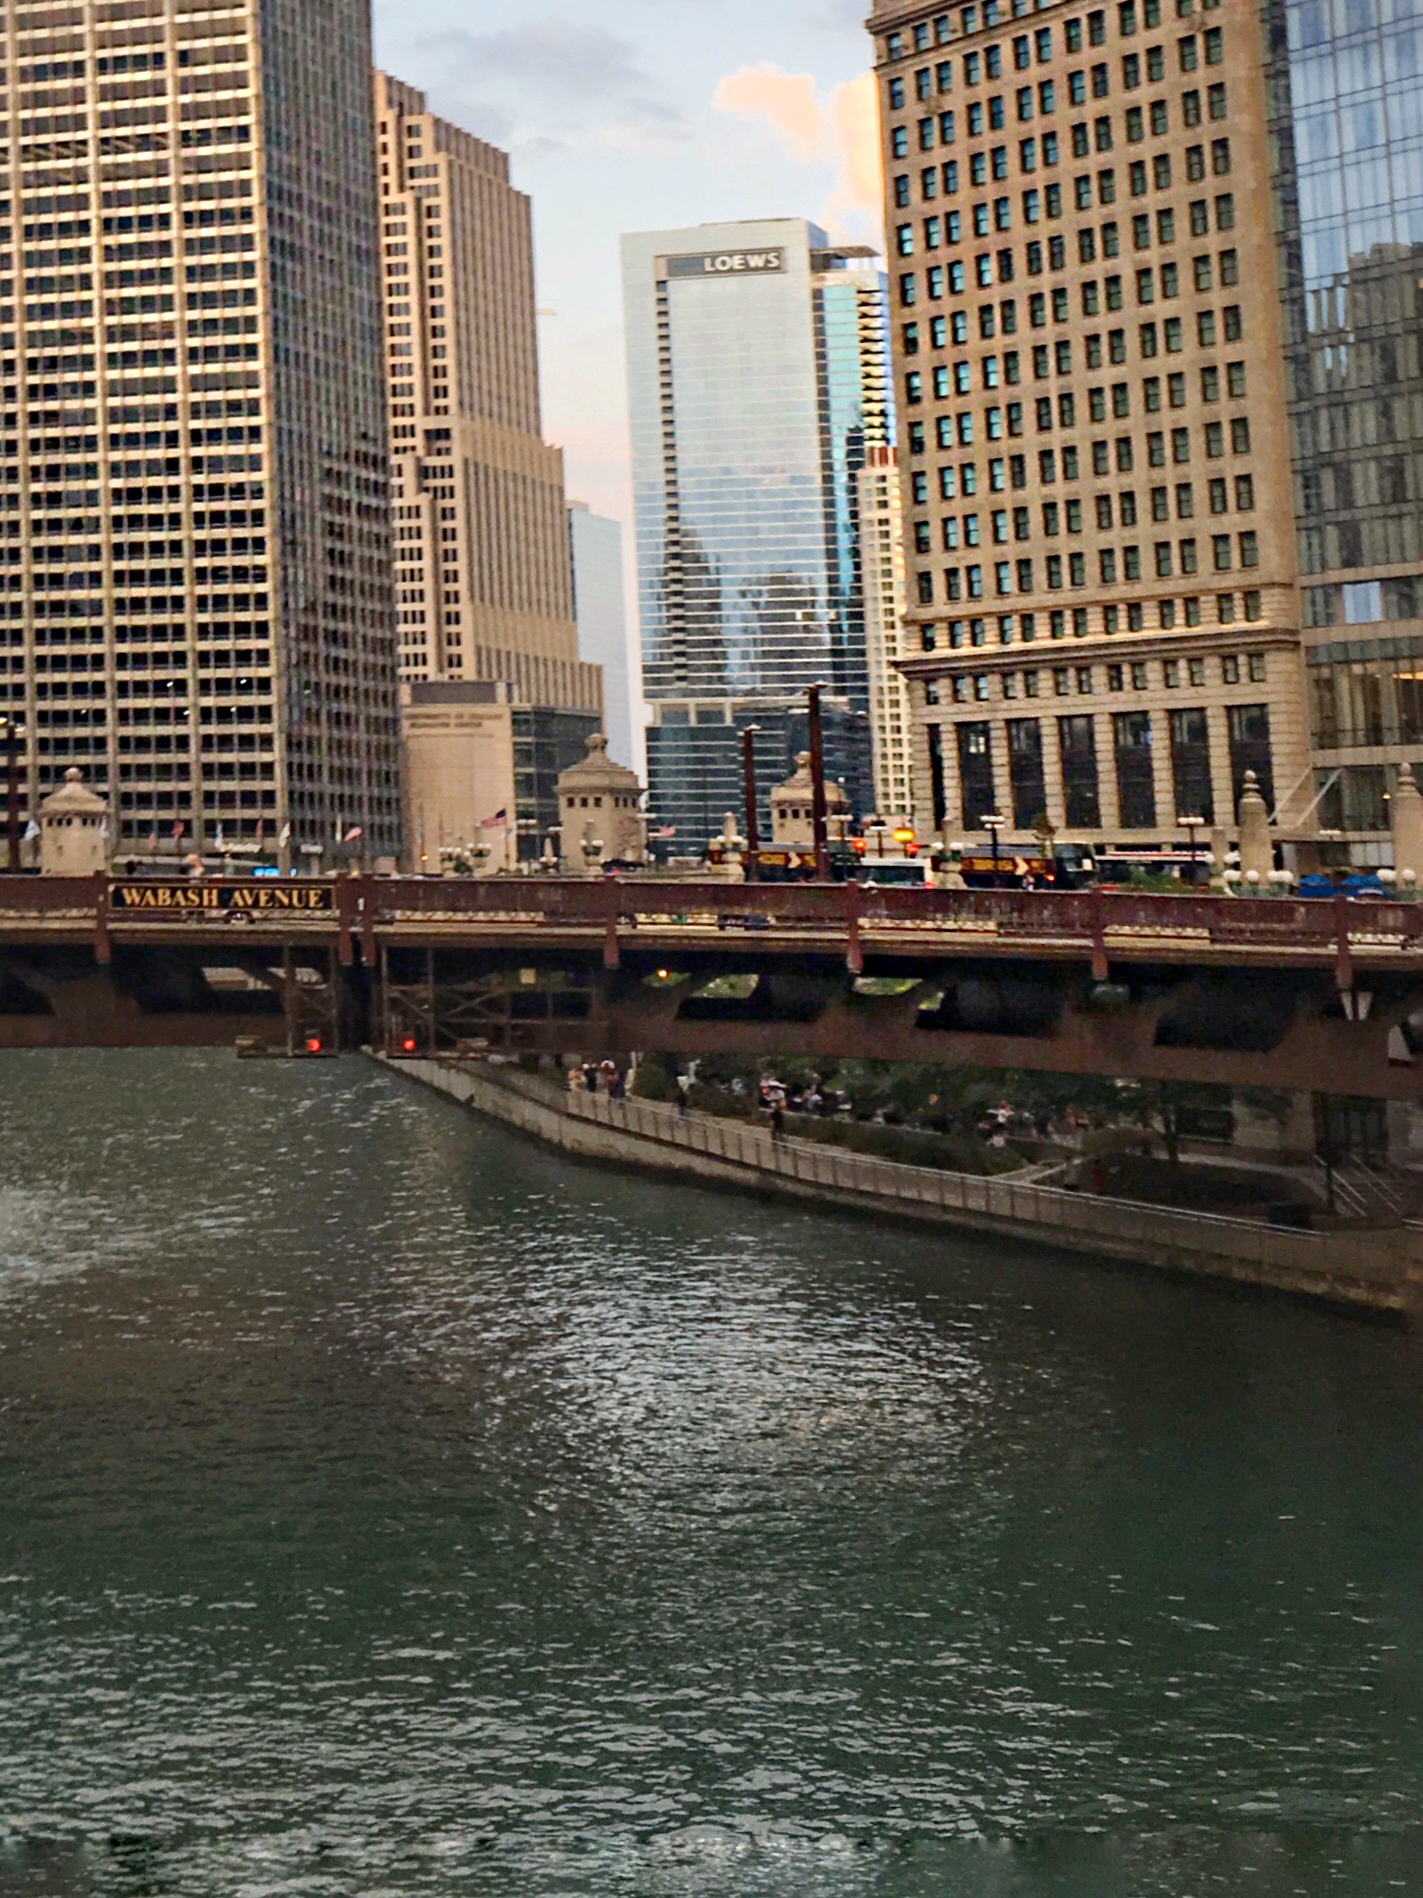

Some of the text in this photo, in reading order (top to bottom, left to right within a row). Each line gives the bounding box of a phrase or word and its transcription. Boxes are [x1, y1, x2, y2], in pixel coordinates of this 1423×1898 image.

[703, 252, 780, 271] LOEWS
[123, 888, 323, 908] WABASH AVENUE
